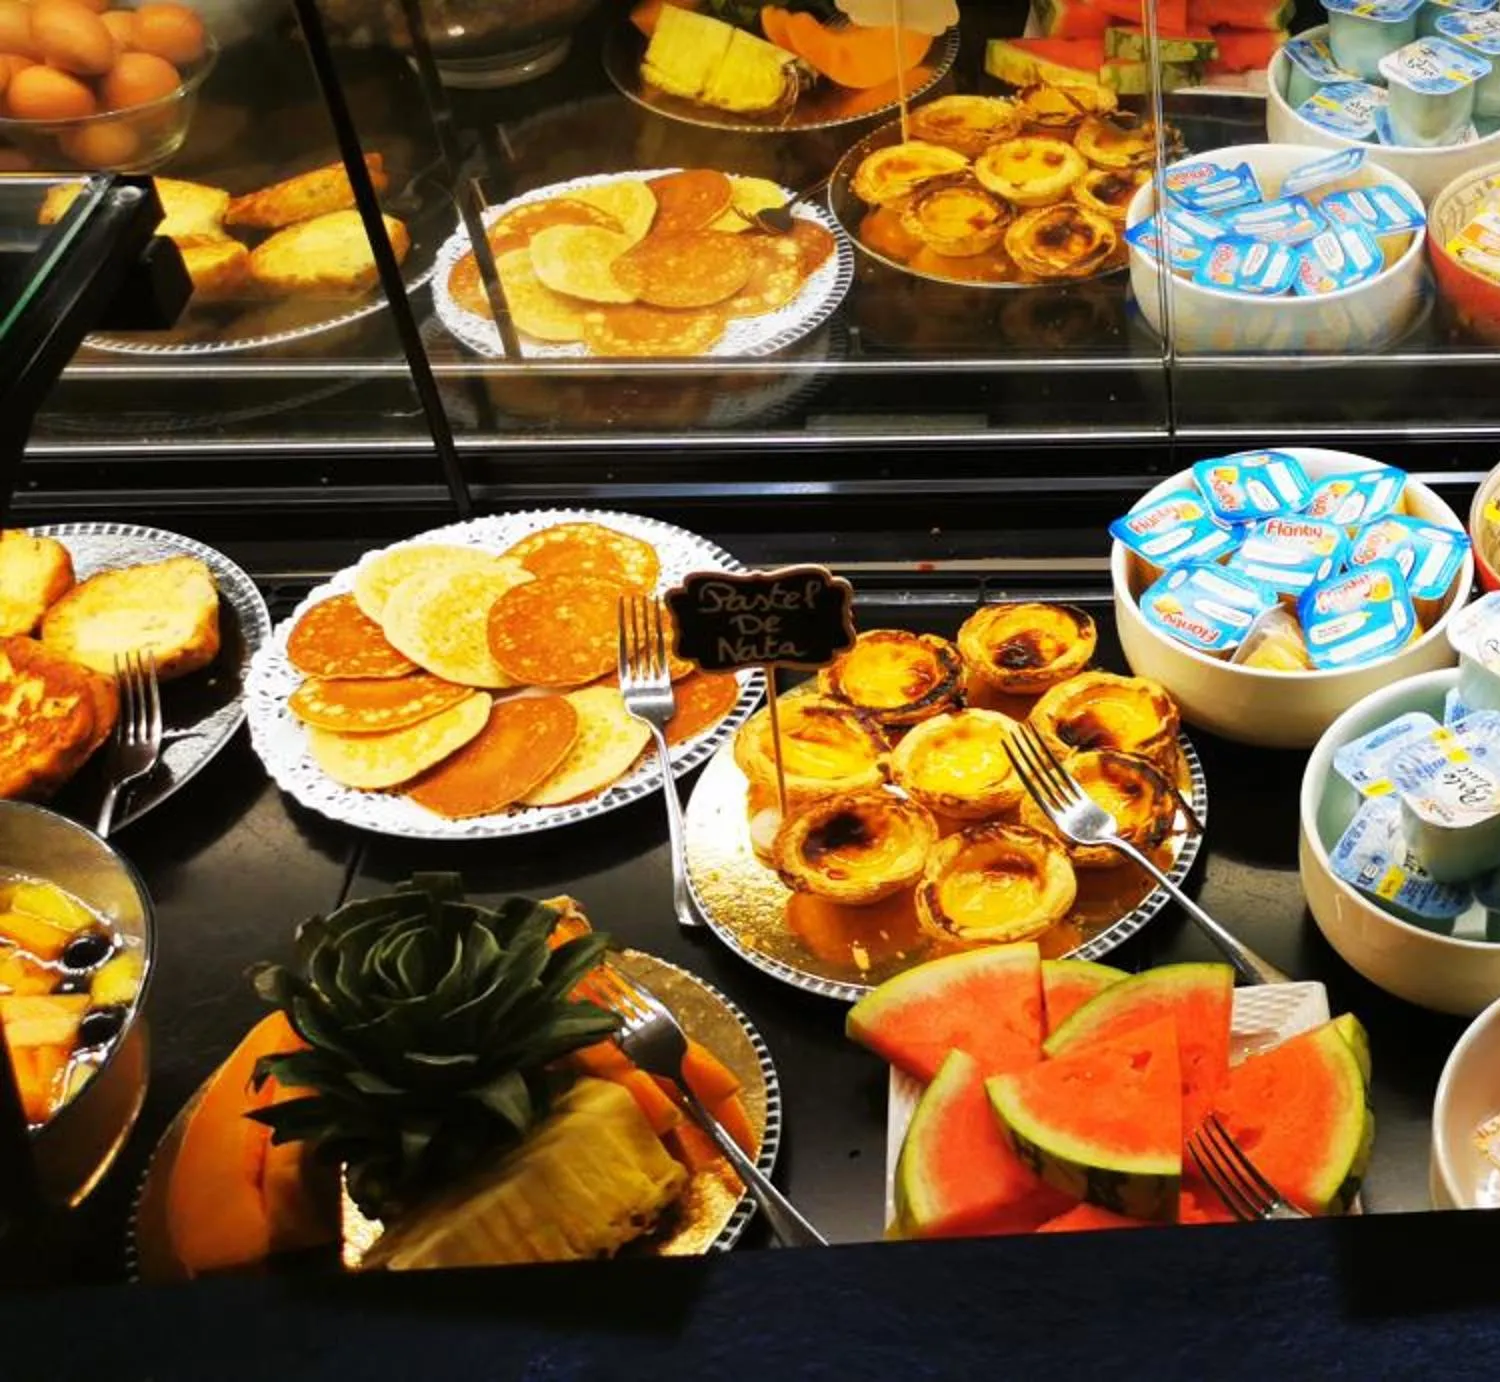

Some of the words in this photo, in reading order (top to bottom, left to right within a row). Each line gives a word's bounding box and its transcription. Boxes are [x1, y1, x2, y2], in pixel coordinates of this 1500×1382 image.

[1266, 517, 1323, 540] Flanby
[698, 580, 821, 613] Pastel
[729, 613, 783, 635] De
[717, 633, 808, 663] Nata
